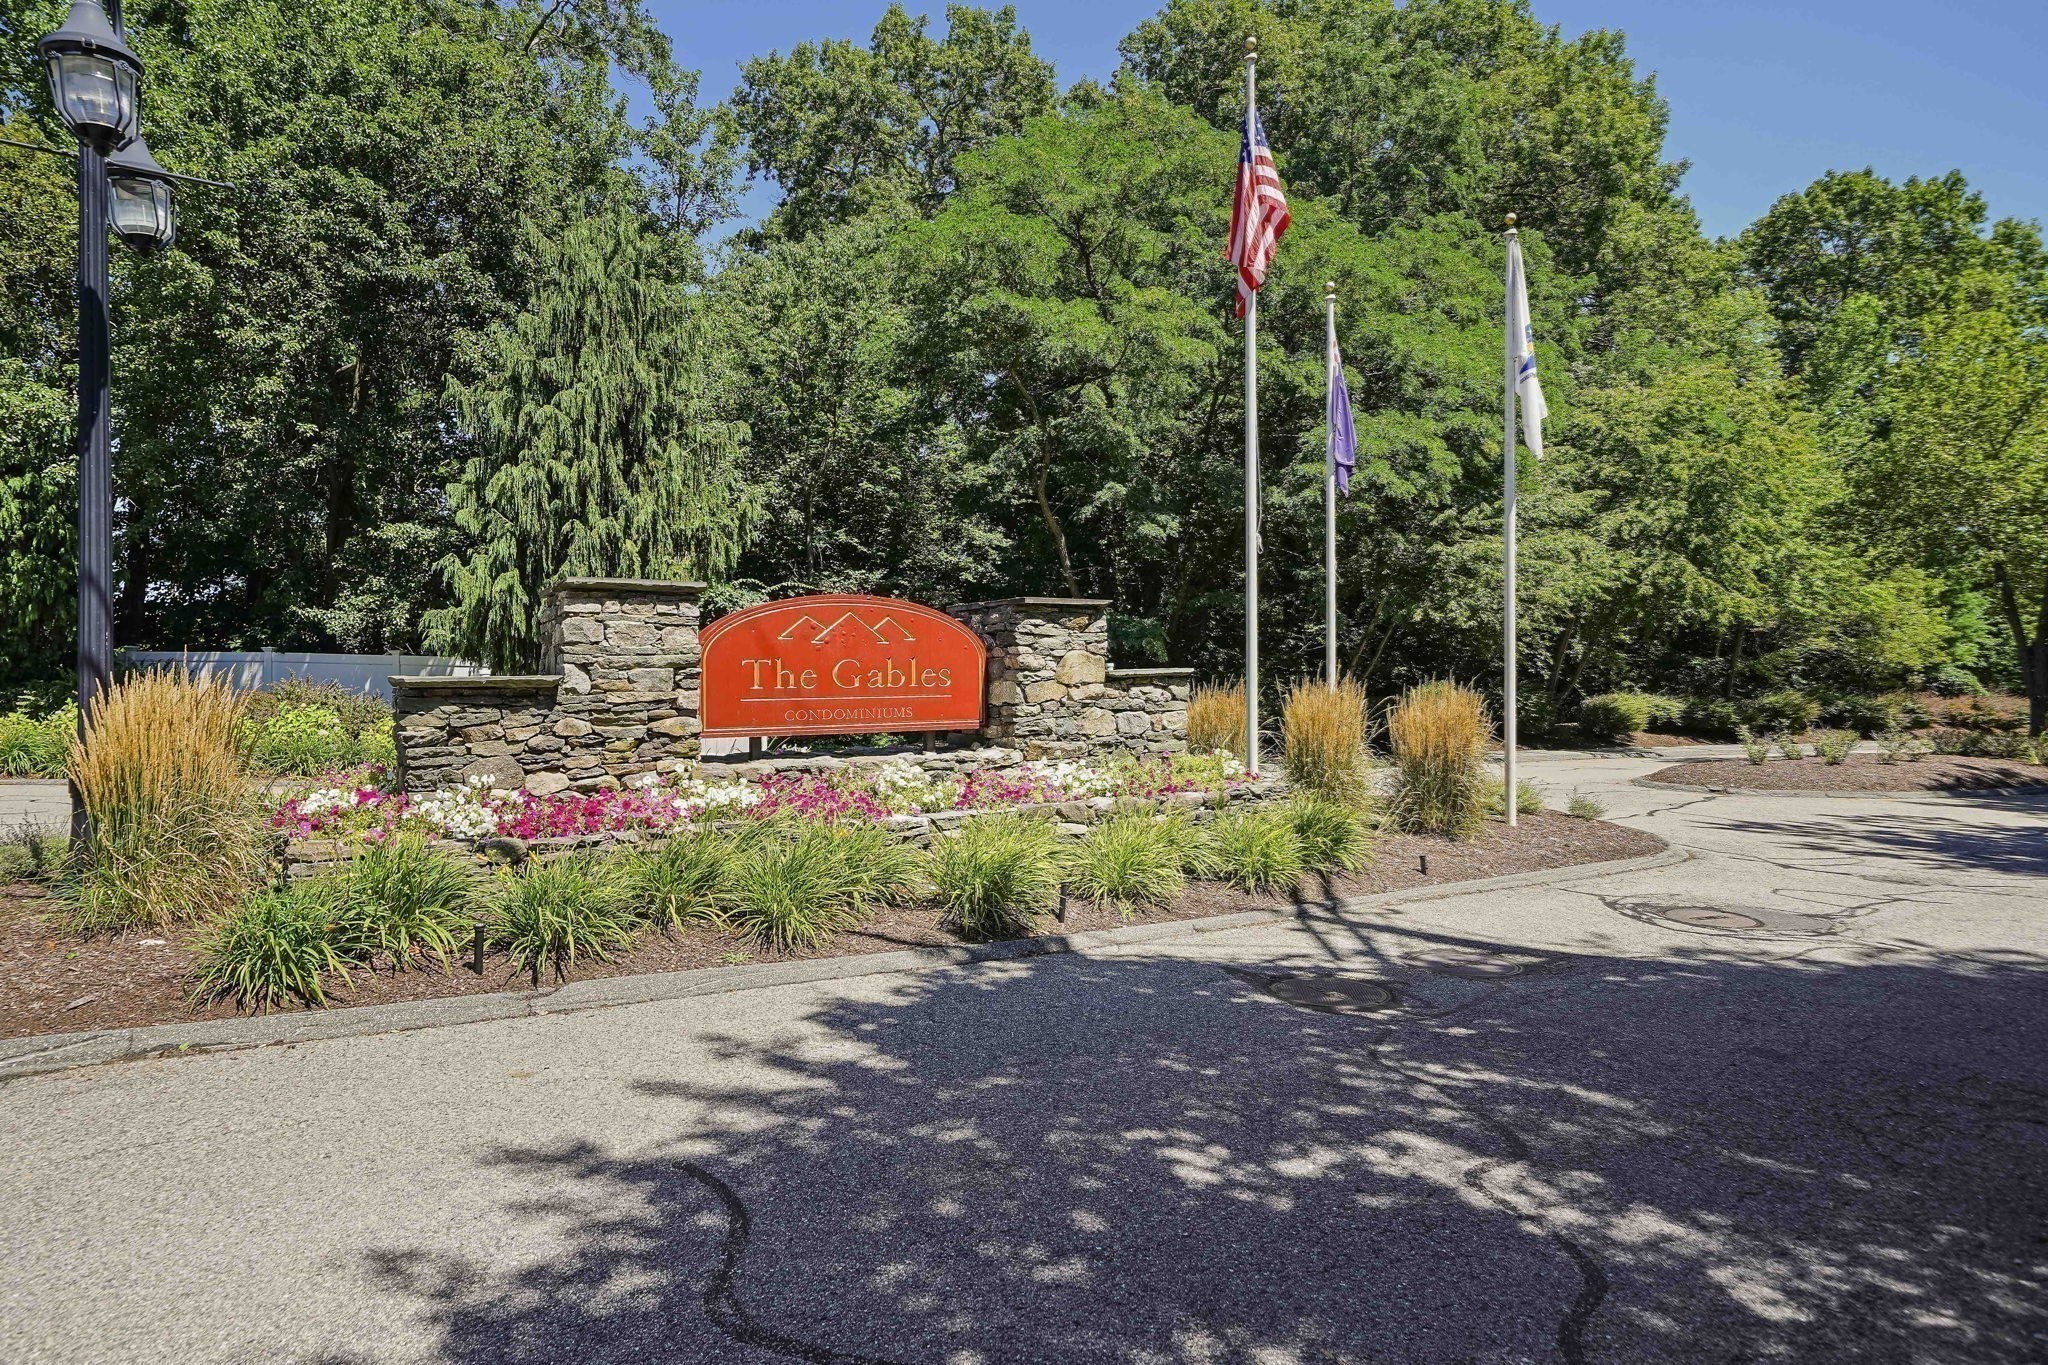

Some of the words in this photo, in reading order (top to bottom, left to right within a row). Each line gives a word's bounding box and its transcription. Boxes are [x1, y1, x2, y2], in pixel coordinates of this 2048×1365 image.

[741, 657, 817, 690] The
[832, 656, 951, 689] Gables
[784, 706, 913, 722] CONDOMINIUMS
